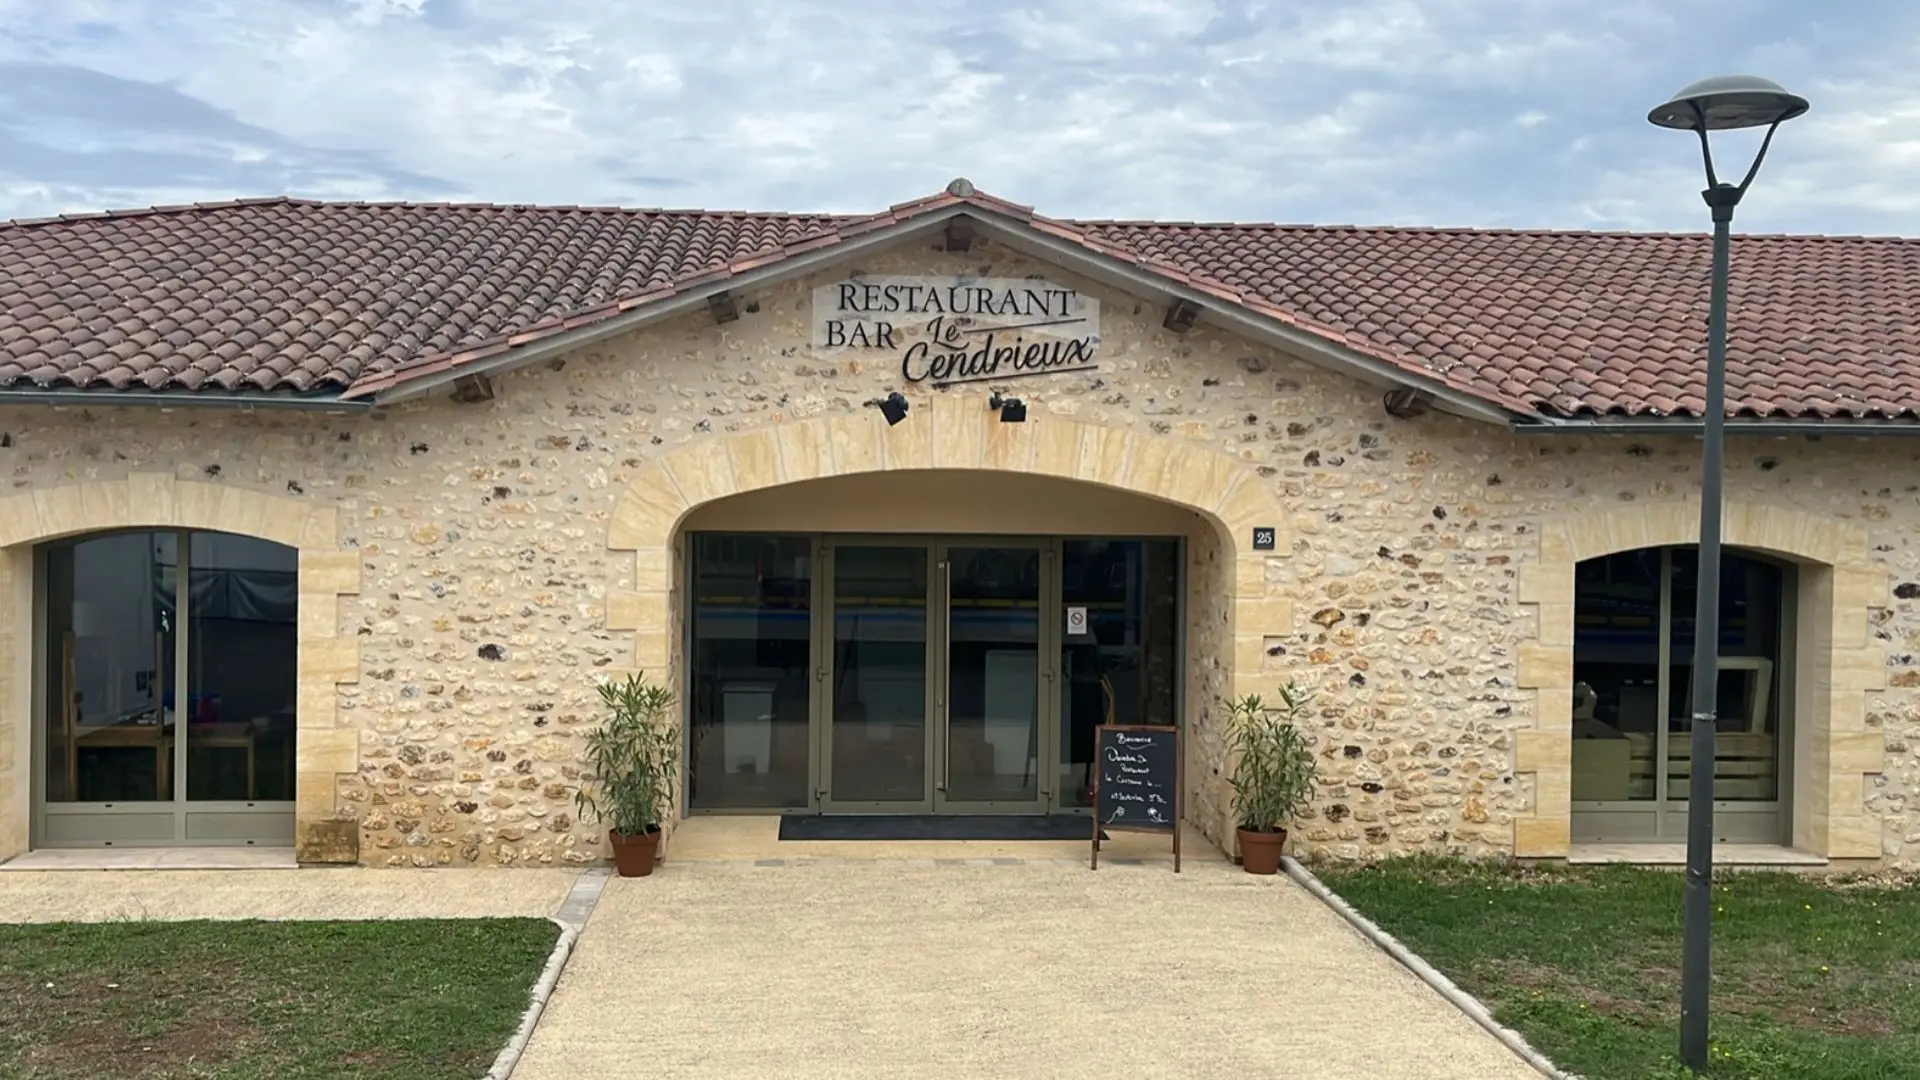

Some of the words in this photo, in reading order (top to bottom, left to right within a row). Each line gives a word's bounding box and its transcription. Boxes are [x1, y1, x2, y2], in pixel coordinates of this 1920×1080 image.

[838, 284, 1076, 316] RESTAURANT
[825, 320, 897, 350] BAR
[926, 315, 971, 350] Le
[902, 333, 1094, 383] Cendrieux
[1256, 531, 1272, 544] 25
